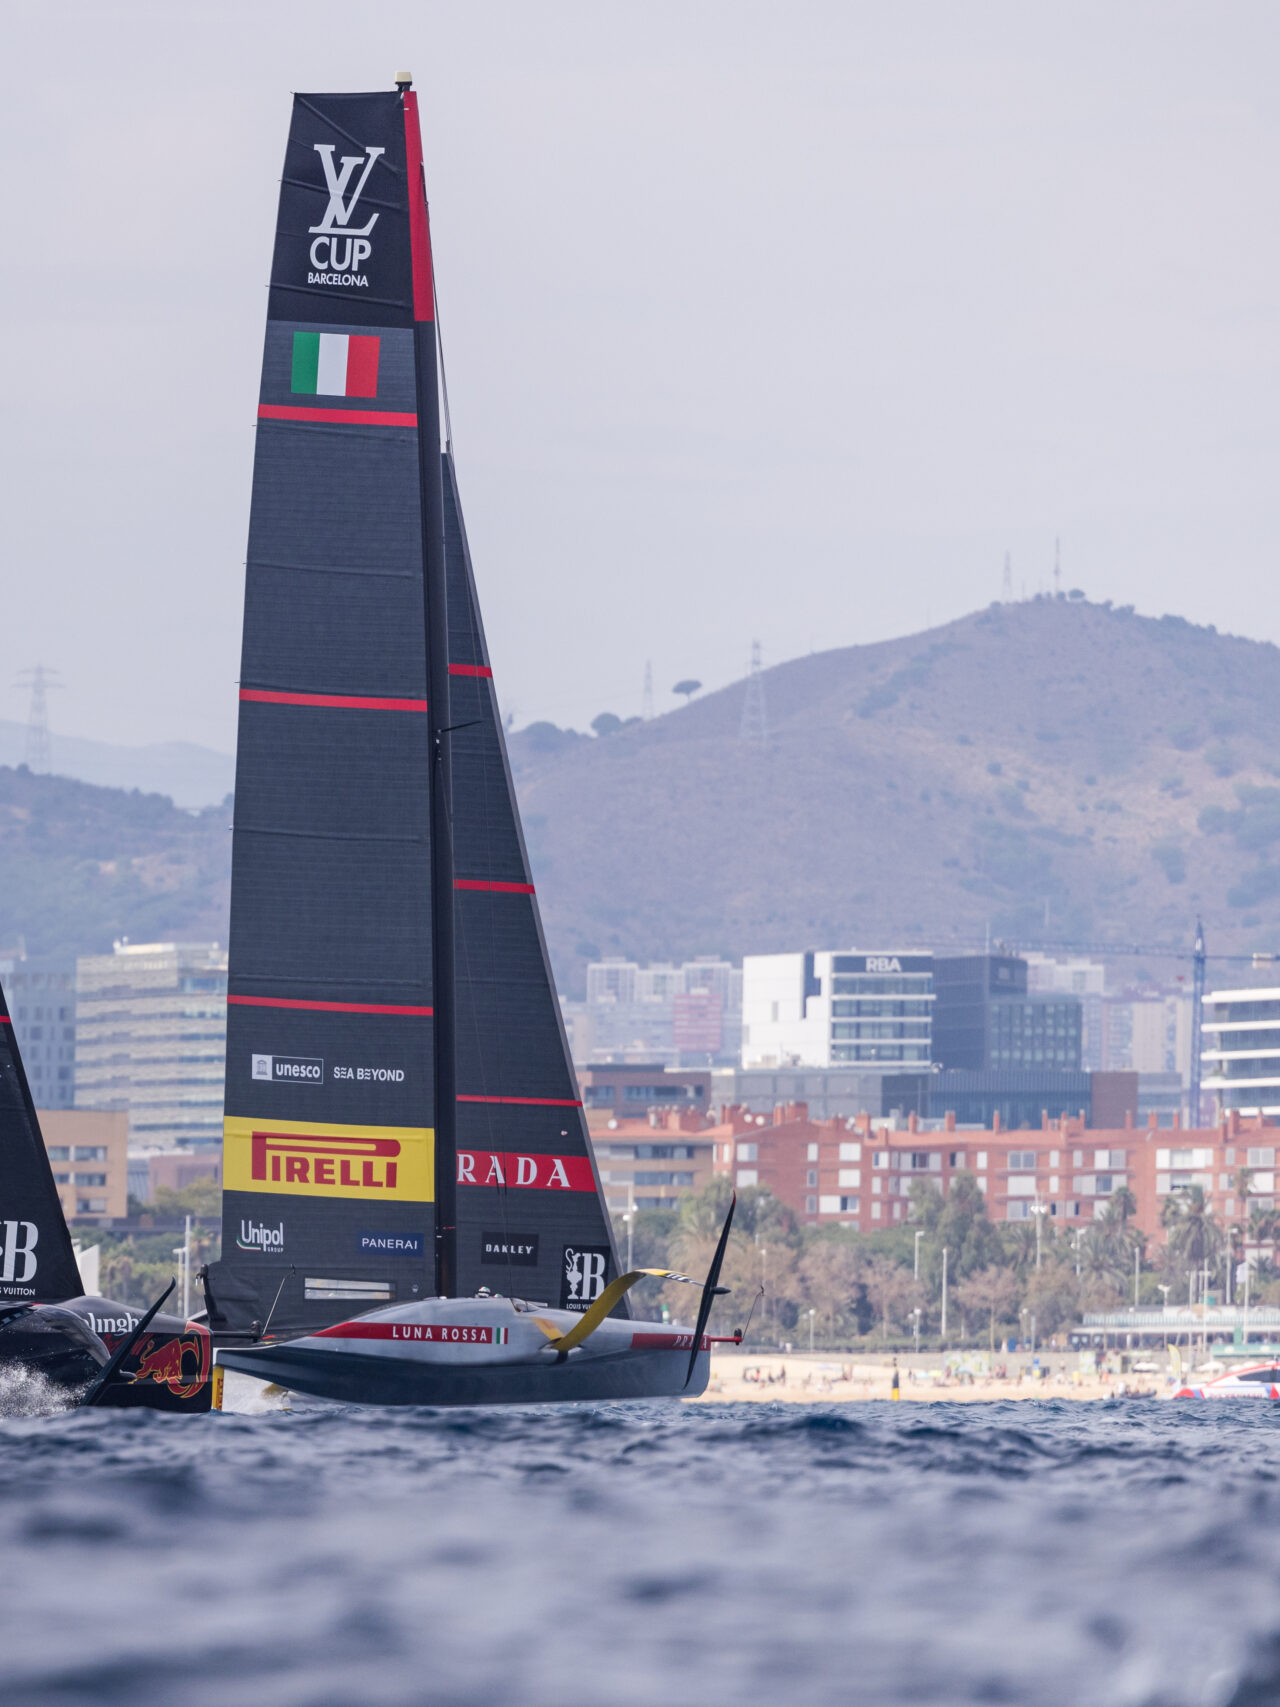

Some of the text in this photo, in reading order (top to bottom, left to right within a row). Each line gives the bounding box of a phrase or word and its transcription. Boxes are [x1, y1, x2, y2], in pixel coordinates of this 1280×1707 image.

[309, 236, 371, 272] CUP
[307, 272, 369, 287] BARCELONA
[866, 956, 902, 973] RBA
[275, 1063, 321, 1078] unesco
[333, 1066, 405, 1082] SEA BEYOND
[251, 1131, 401, 1188] PIRELLI
[457, 1153, 571, 1188] RADA
[241, 1219, 284, 1252] Unipol
[361, 1237, 418, 1250] PANERAI
[485, 1243, 534, 1255] OAKLEY
[2, 1286, 36, 1297] VUITTON
[84, 1312, 146, 1337] lingh
[392, 1326, 487, 1341] LUNA ROSSA
